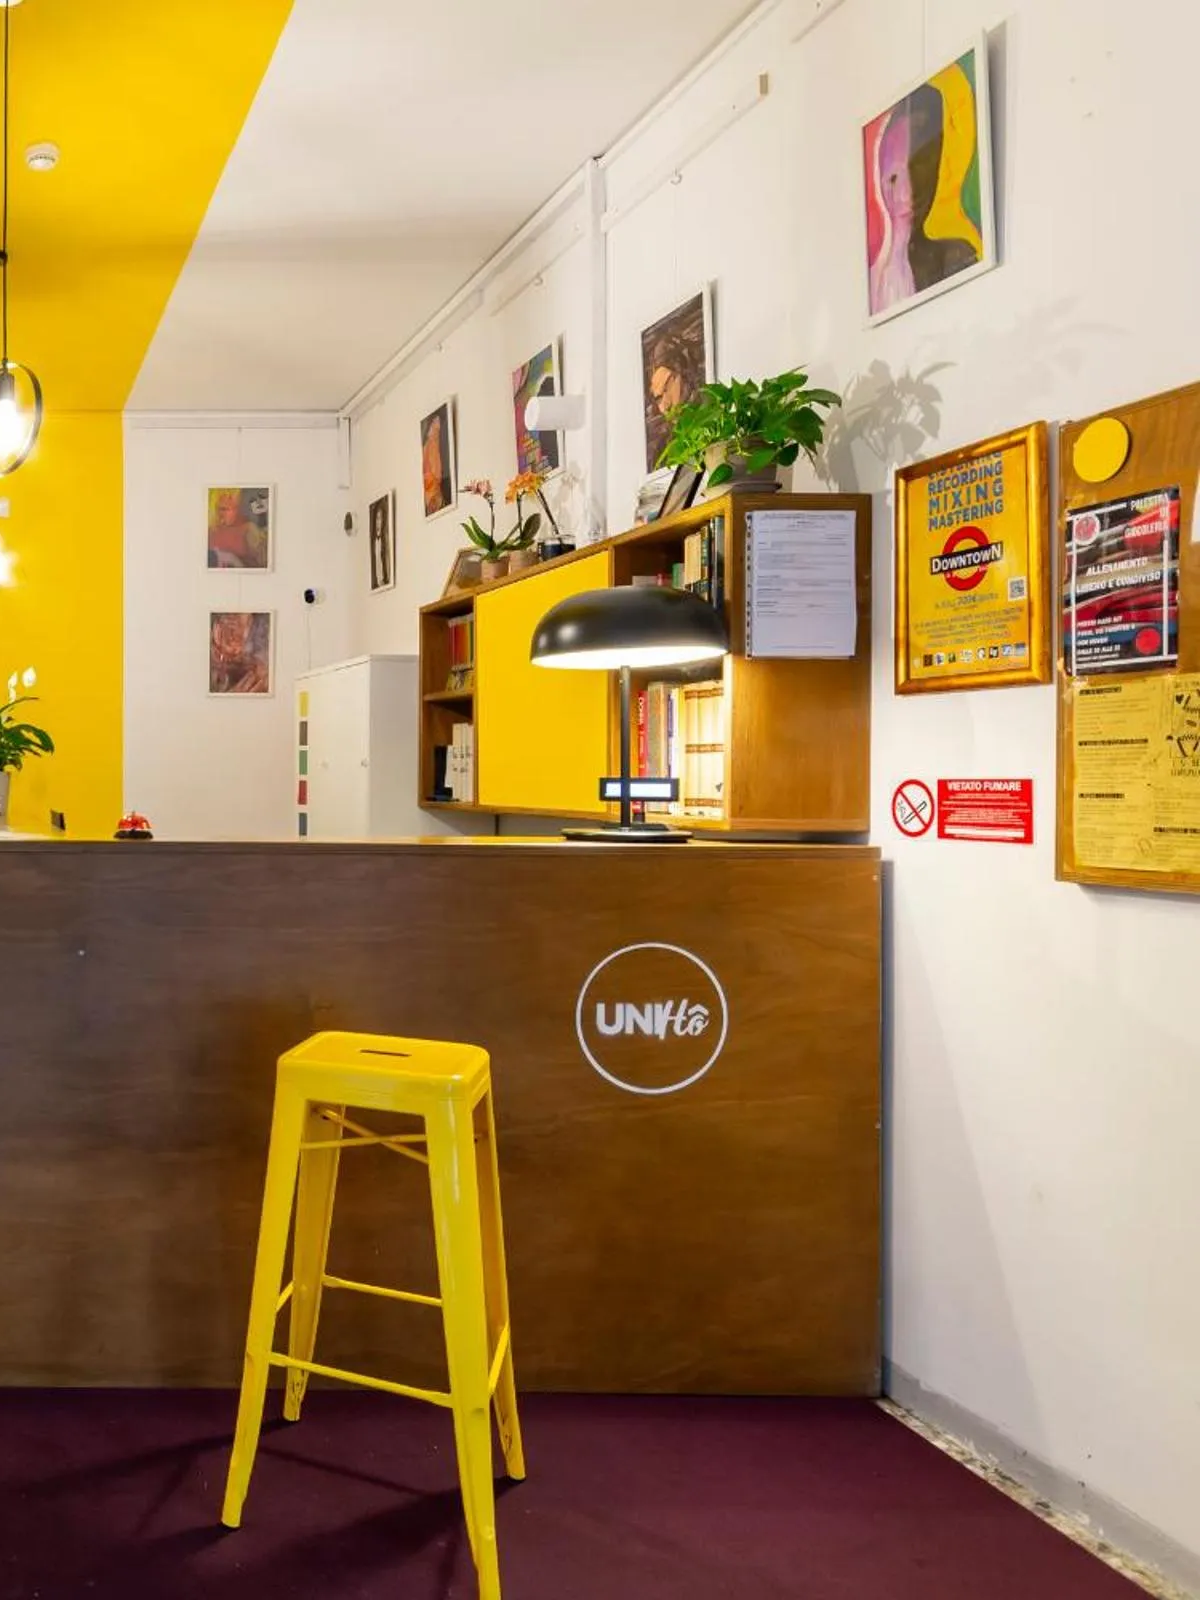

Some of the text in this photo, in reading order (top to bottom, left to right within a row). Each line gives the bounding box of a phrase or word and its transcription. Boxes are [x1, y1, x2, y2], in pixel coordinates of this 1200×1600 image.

[928, 460, 1003, 495] RECORDING
[928, 478, 1004, 515] MIXING
[928, 498, 1004, 531] MASTERING
[1085, 556, 1148, 577] ALLENAMENTO
[1116, 570, 1161, 587] CONDIVISO
[947, 781, 1022, 791] VIETATO FUMARE
